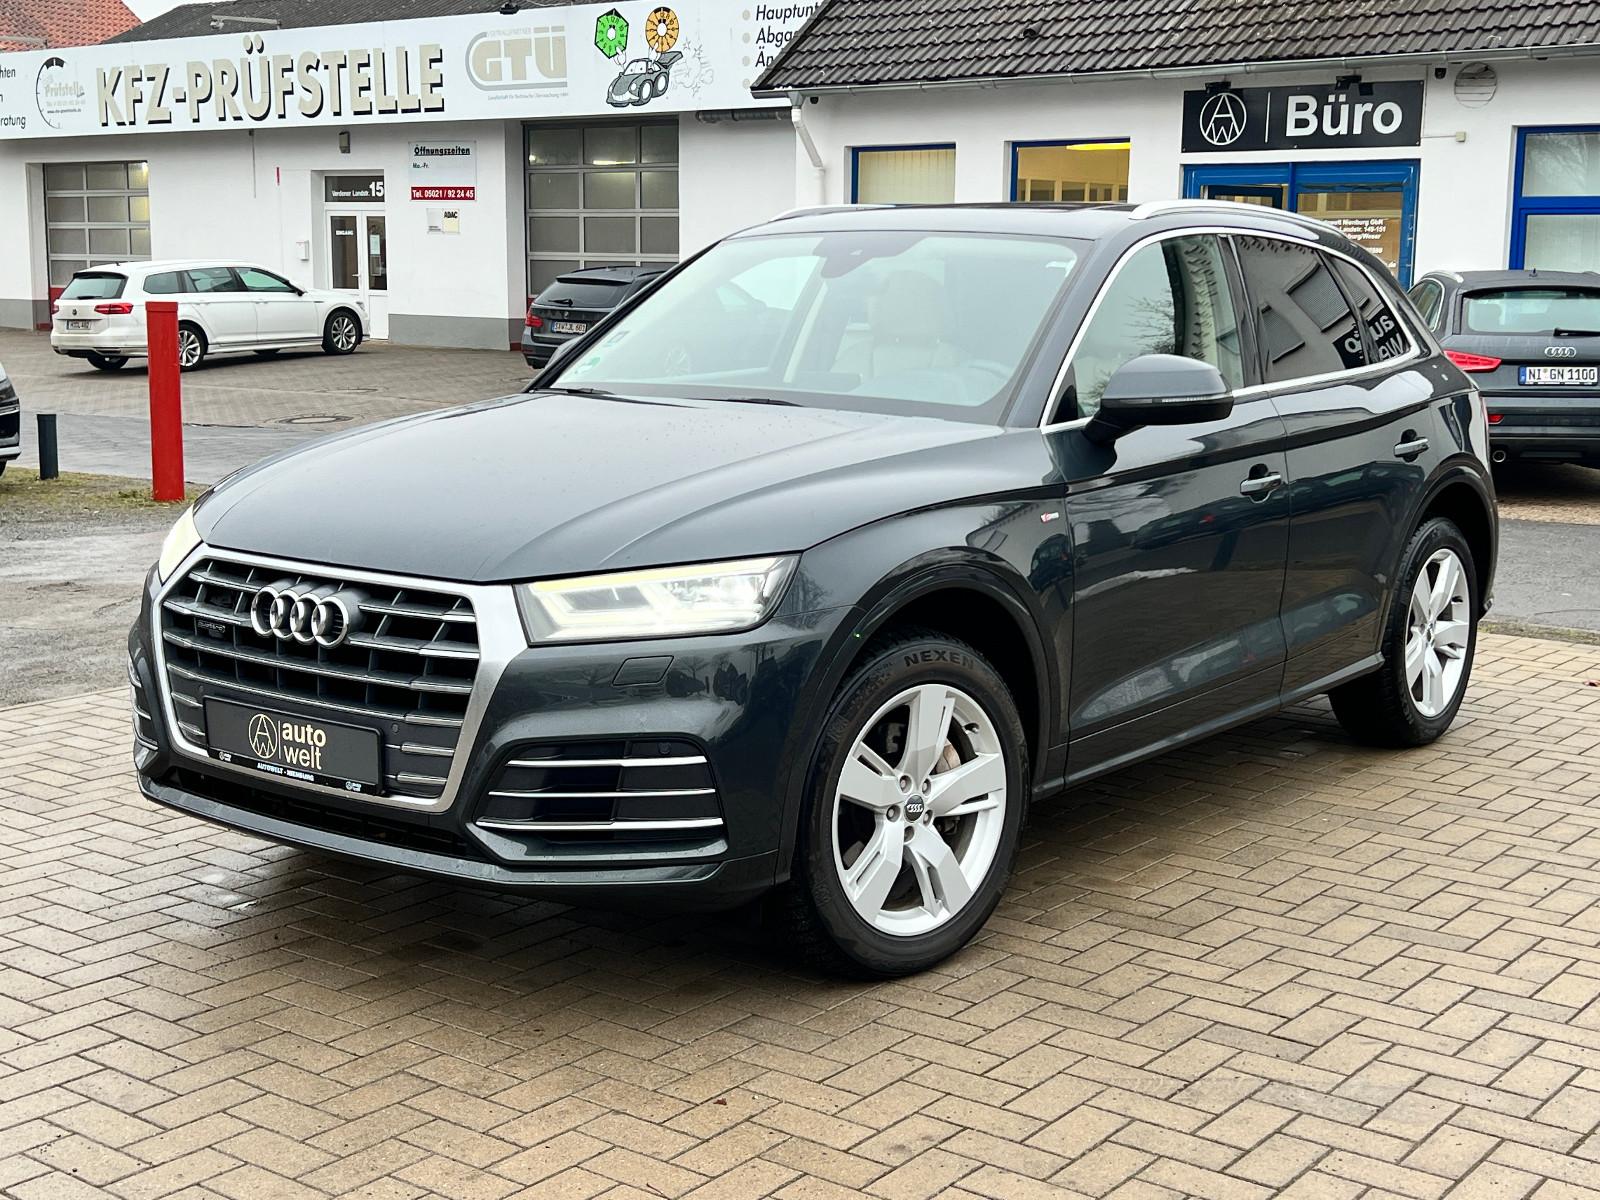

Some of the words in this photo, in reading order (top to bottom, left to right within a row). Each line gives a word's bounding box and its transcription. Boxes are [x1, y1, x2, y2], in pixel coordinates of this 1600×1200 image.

[756, 26, 793, 48] Abga
[472, 26, 567, 81] GTÜ
[96, 34, 445, 127] KFZ-PRÜFSTELLE
[1286, 94, 1403, 137] Büro
[414, 145, 471, 156] Öffnungszeiten
[369, 182, 384, 197] 15
[413, 190, 423, 198] Tel.
[425, 190, 442, 198] 05021
[448, 190, 456, 198] 92
[457, 189, 465, 198] 24
[466, 189, 474, 198] 45
[1528, 368, 1542, 380] NI
[1550, 368, 1564, 380] GN
[1567, 368, 1596, 380] 1100
[904, 650, 974, 670] NEXEN
[282, 722, 327, 748] auto
[283, 745, 322, 770] welt
